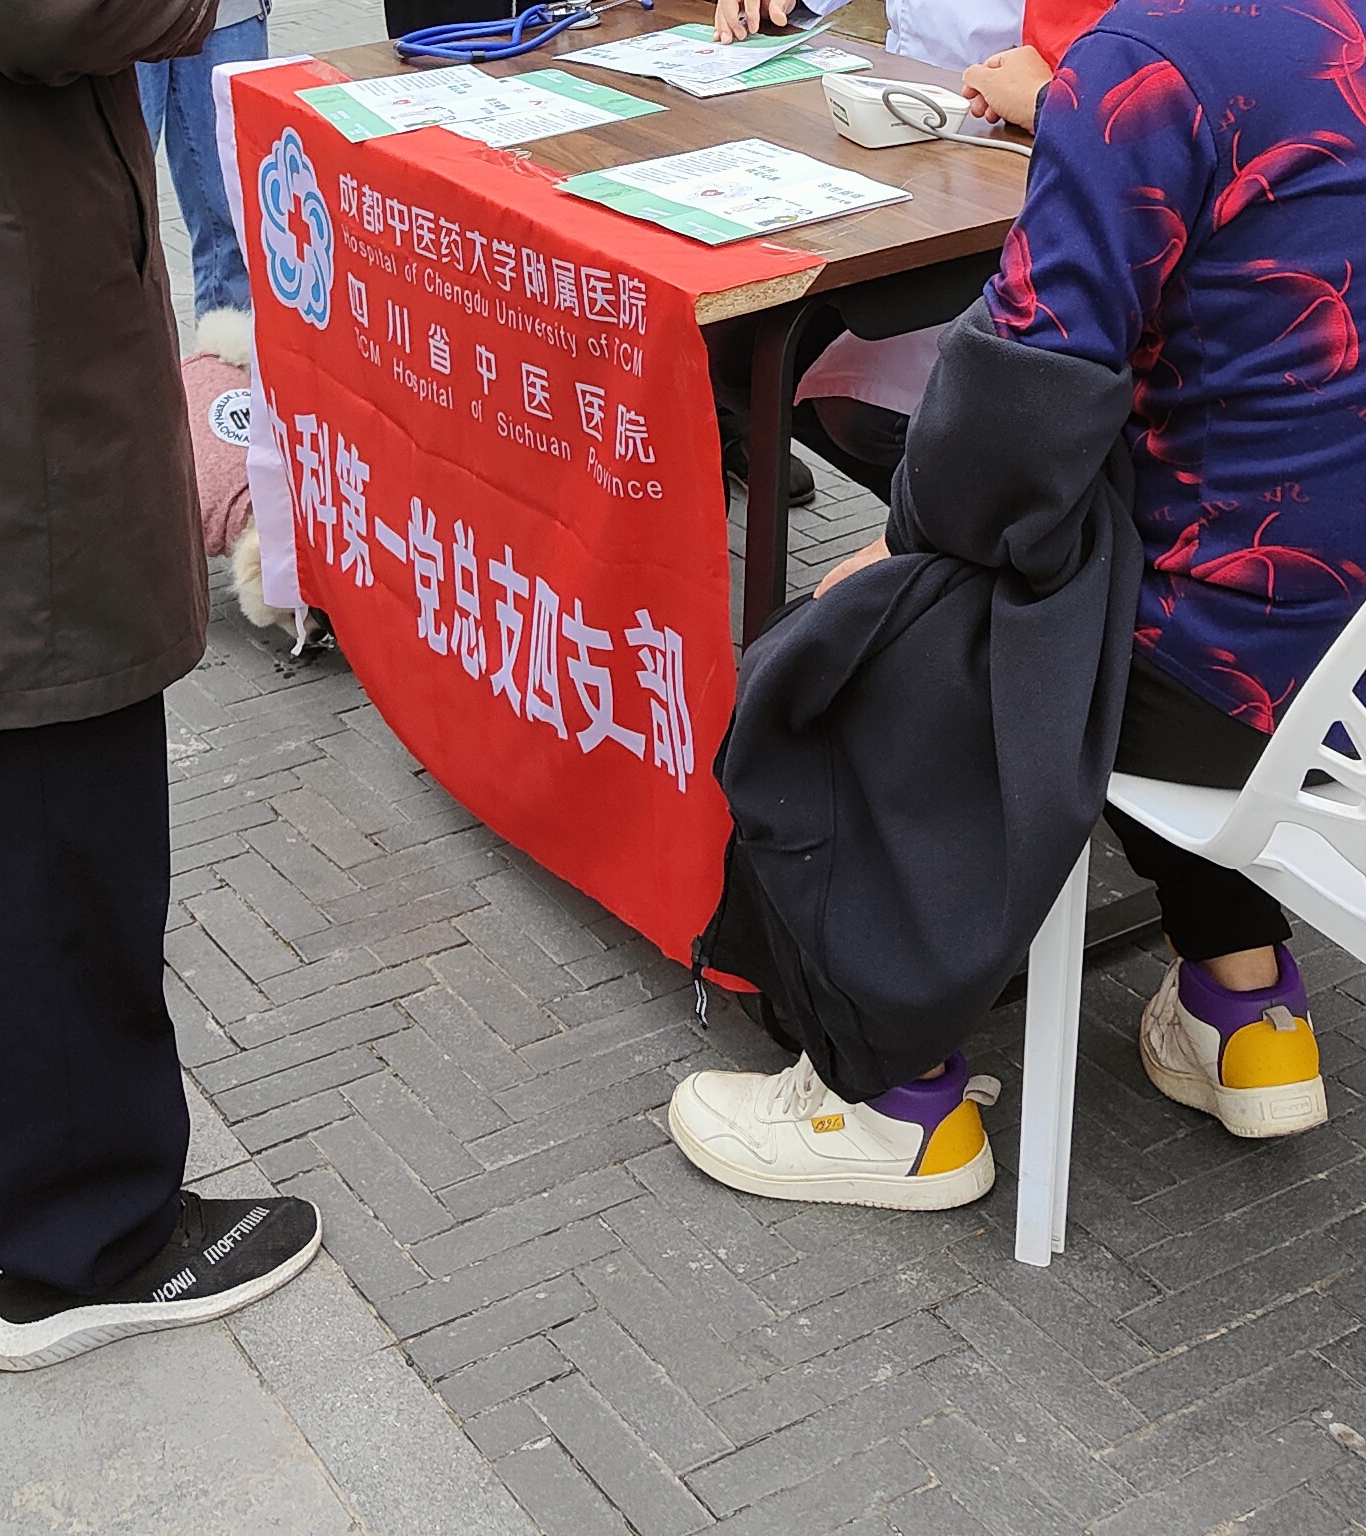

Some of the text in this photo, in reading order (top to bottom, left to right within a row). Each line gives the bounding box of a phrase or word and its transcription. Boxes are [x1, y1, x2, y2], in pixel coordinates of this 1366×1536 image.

[339, 173, 647, 335] 成都中医药大学附属医院
[341, 224, 643, 378] Hospital of Chengdu University of TCM
[347, 271, 656, 464] 四川省中医医院
[393, 357, 453, 410] Hospital
[471, 399, 483, 423] of
[497, 411, 571, 461] Sichuan
[587, 446, 663, 500] Province
